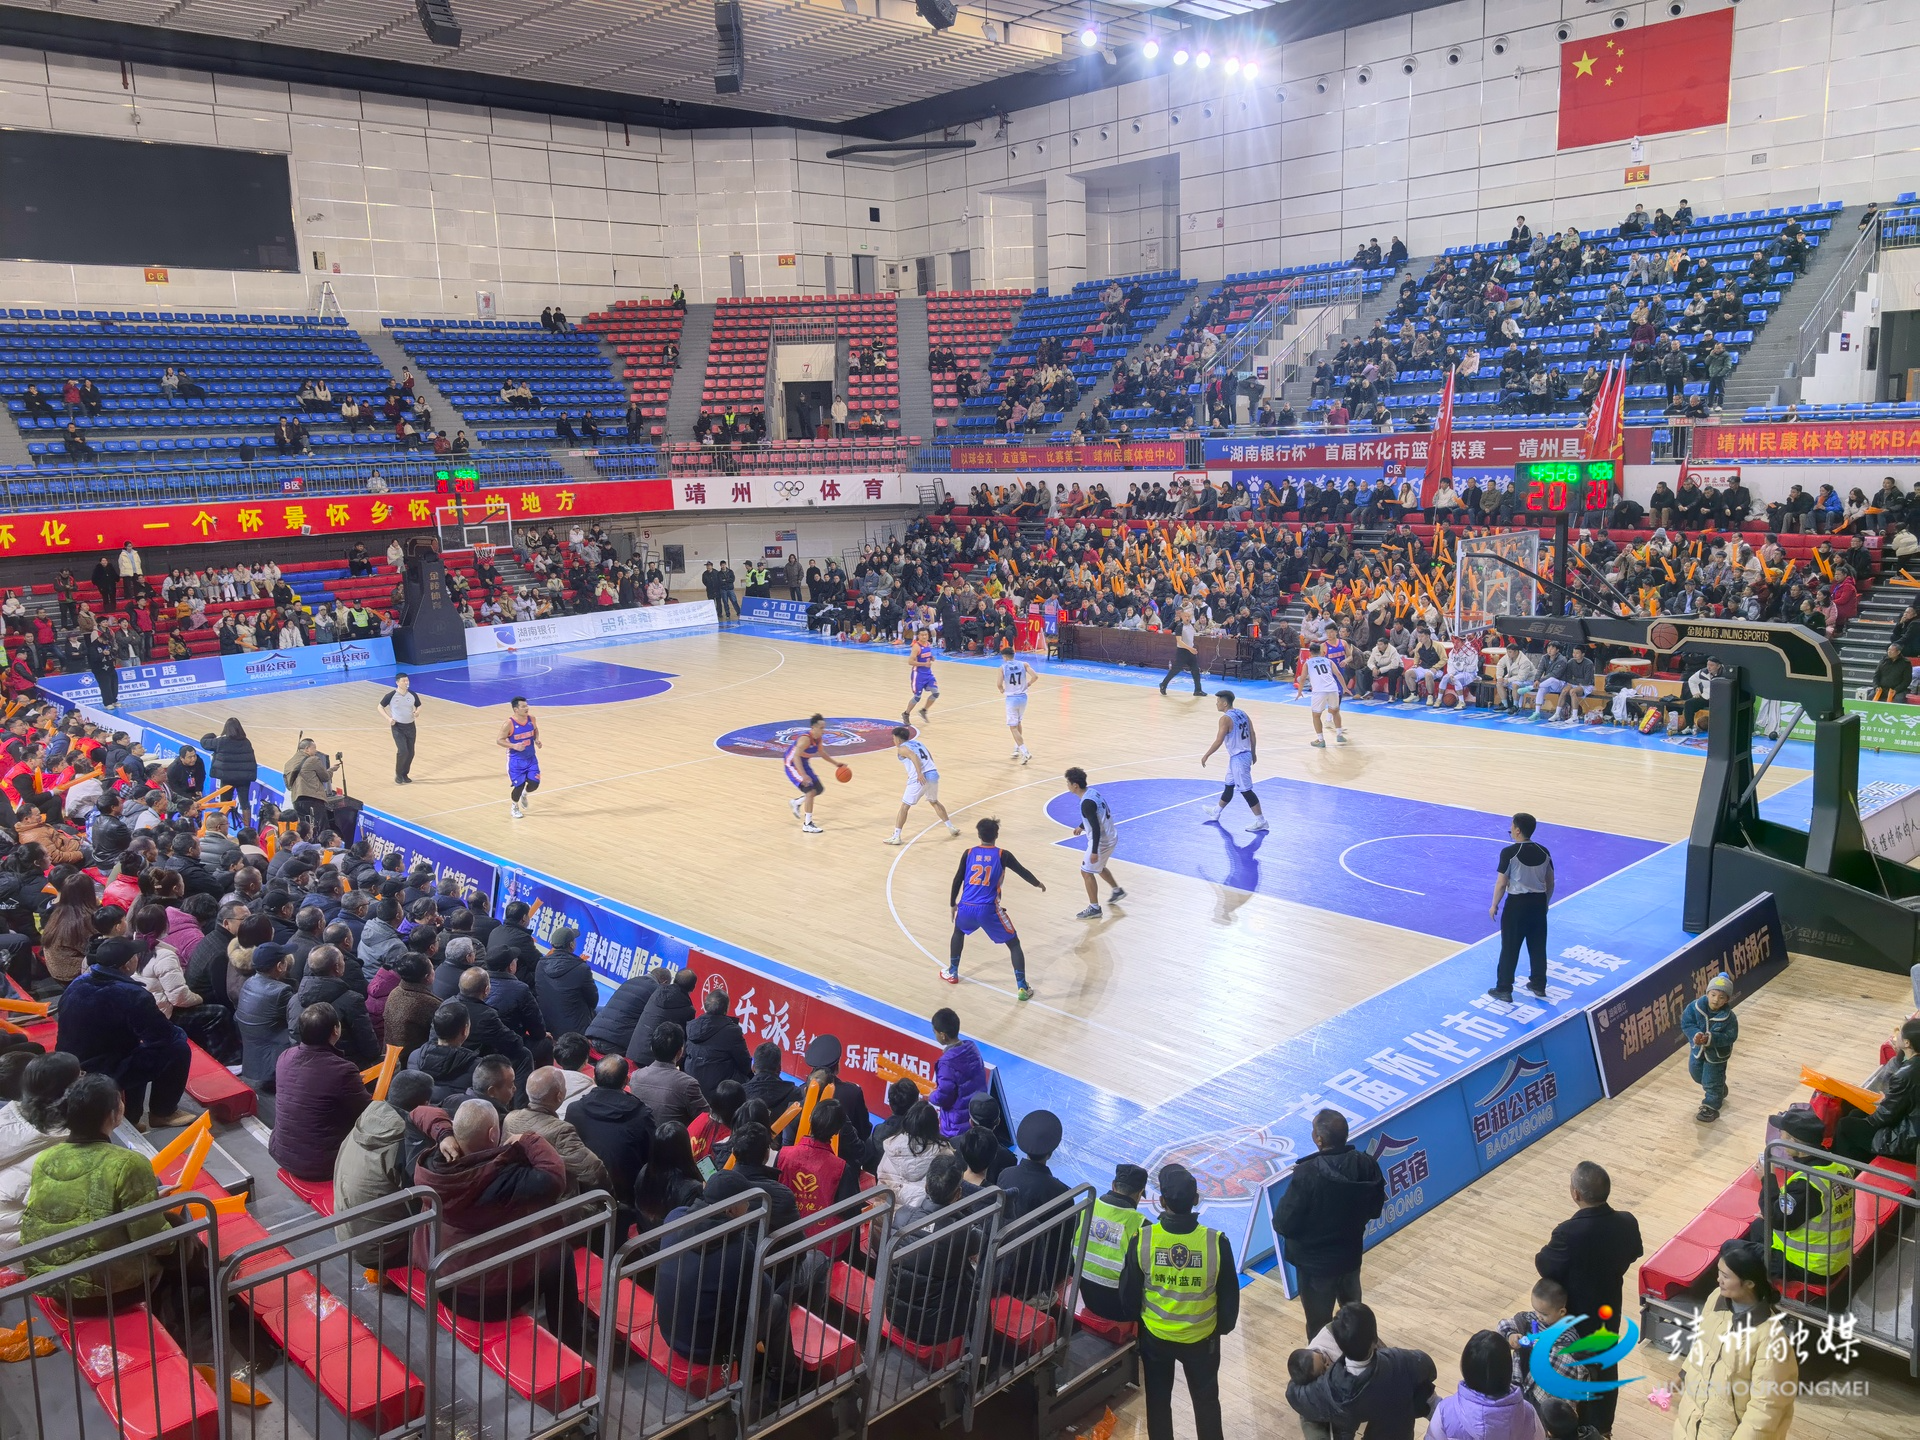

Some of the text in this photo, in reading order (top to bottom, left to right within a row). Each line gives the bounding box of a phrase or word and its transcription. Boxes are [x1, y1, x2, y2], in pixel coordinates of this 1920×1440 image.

[803, 363, 810, 373] 7
[1093, 447, 1177, 464] 靖州民康体检中心
[1325, 439, 1486, 461] 首届怀化市篮联赛
[284, 480, 301, 491] B区
[455, 478, 475, 493] 20
[684, 479, 885, 505] 靖州 体育
[1526, 481, 1567, 511] 20
[1586, 480, 1608, 511] 20
[644, 530, 650, 539] 5
[517, 624, 557, 638] 湖南银行
[1029, 619, 1040, 632] 70
[1045, 621, 1056, 633] 74
[1719, 628, 1743, 640] JINLING
[1743, 630, 1770, 642] SPORTS
[245, 660, 297, 675] 包租公民宿
[326, 660, 367, 671] BAOZGONG
[1314, 663, 1328, 676] 10
[1009, 672, 1022, 686] 47
[969, 864, 992, 887] 21
[1620, 983, 1685, 1061] 湖南银行
[1473, 1072, 1559, 1144] 包租公民宿
[1486, 1104, 1554, 1161] BAOZUGONG
[1154, 1273, 1203, 1287] 靖州蓝盾
